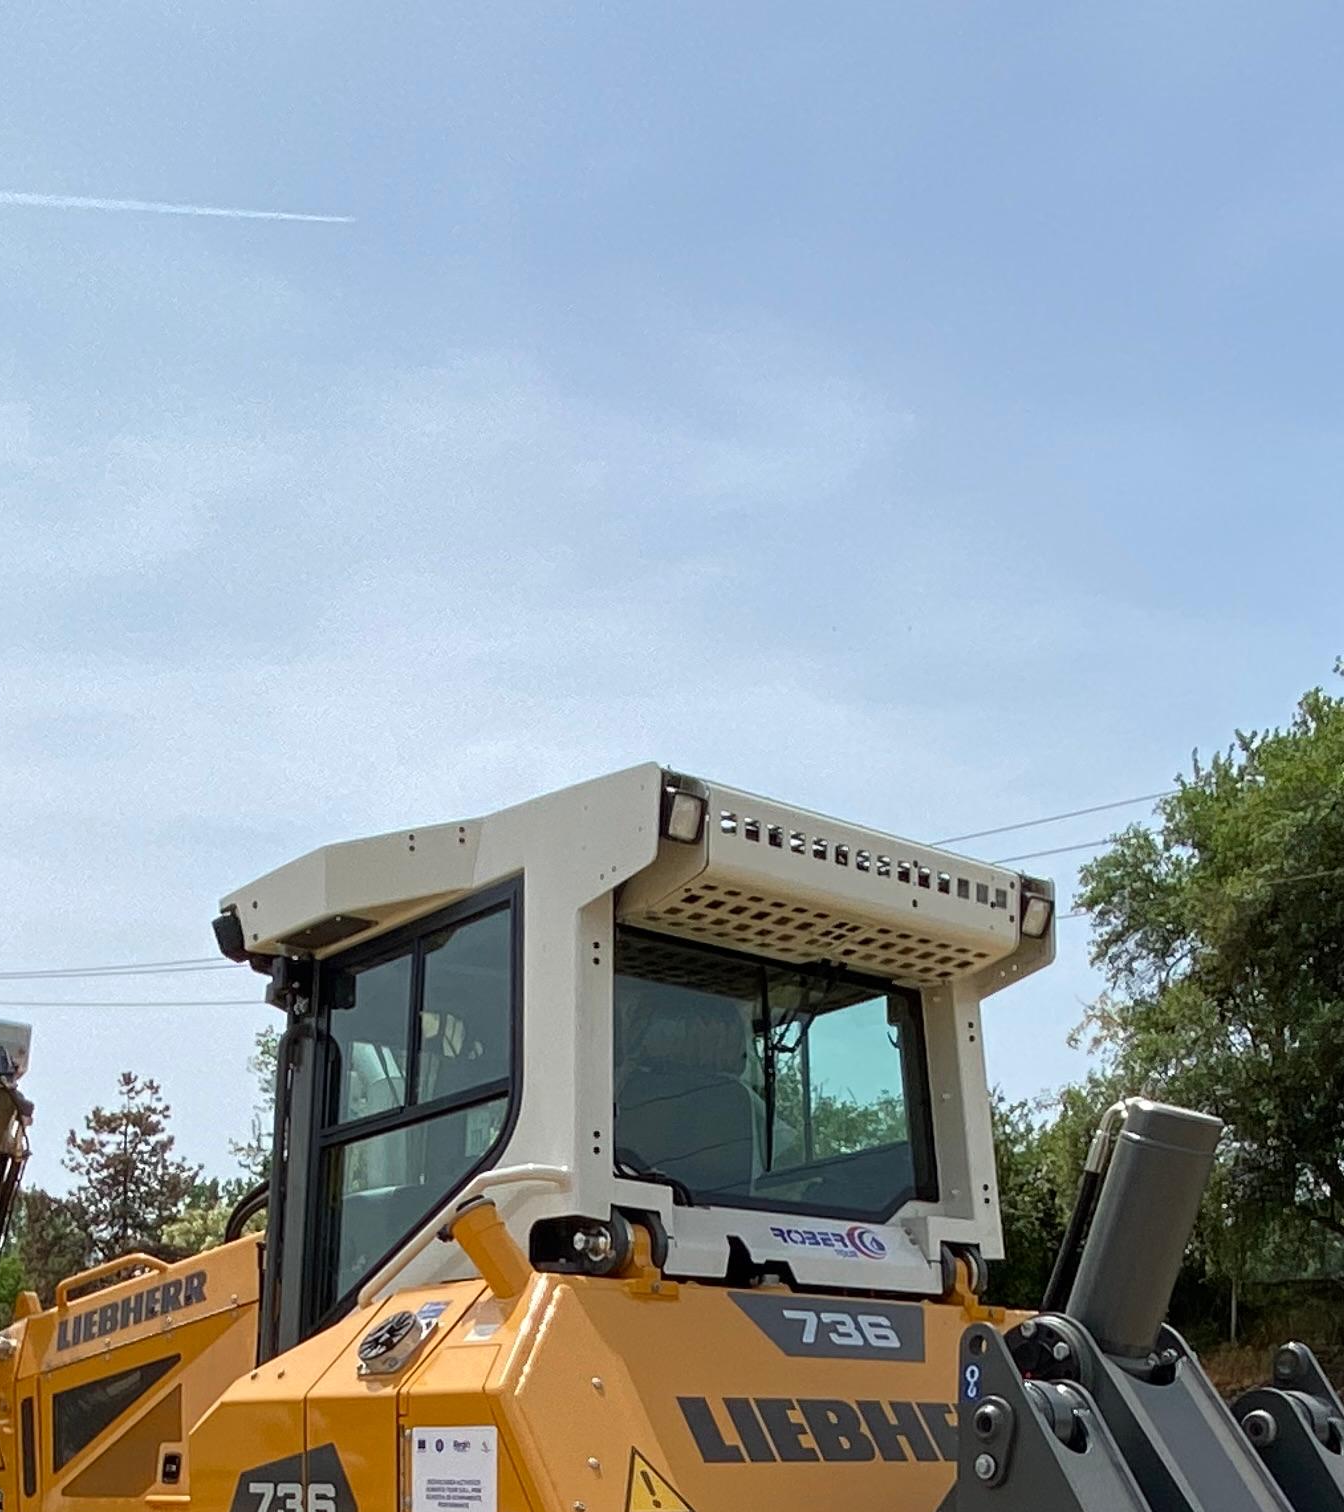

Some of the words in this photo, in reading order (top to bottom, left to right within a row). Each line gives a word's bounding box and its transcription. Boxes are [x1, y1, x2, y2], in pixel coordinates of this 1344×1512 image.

[769, 1226, 849, 1249] ROBER
[57, 1270, 207, 1350] LIEBHERR
[782, 1309, 901, 1348] 736
[676, 1396, 959, 1463] LIEBHE
